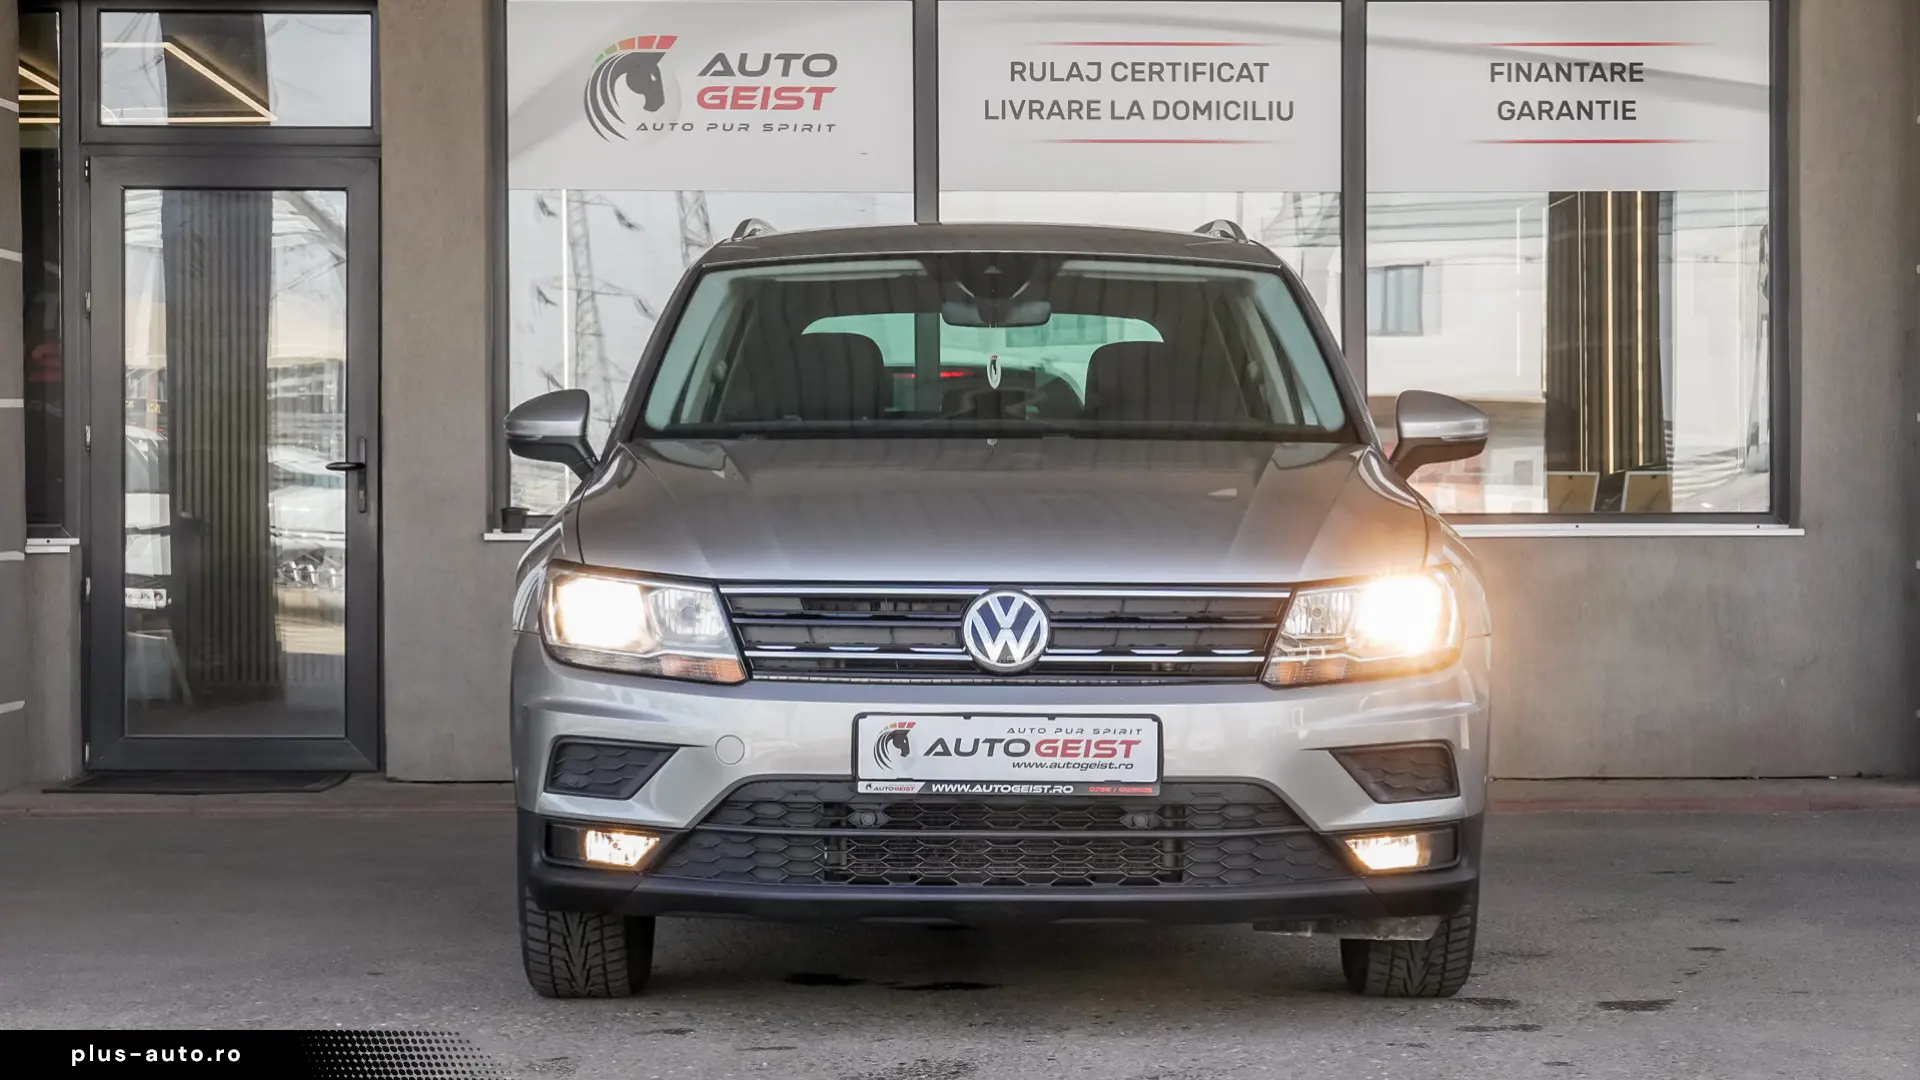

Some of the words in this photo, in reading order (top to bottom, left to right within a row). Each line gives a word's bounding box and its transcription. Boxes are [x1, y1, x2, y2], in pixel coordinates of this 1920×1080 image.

[696, 52, 838, 78] AUTO
[1009, 61, 1102, 83] RULAJ
[1110, 61, 1270, 83] CERTIFICAT
[1489, 62, 1645, 83] FINANTARE
[696, 85, 838, 111] GEIST
[984, 99, 1102, 121] LIVRARE
[1109, 99, 1146, 121] LA
[1152, 99, 1295, 122] DOMICILIU
[1496, 99, 1637, 121] GARANTIE
[635, 122, 695, 132] AUTO
[706, 122, 751, 133] PUR
[762, 122, 838, 133] SPIRIT
[1006, 726, 1047, 735] AUTO
[1054, 726, 1085, 736] PUR
[1092, 727, 1144, 736] SPIRIT
[1011, 759, 1135, 772] www.autogeist.ro
[931, 783, 1074, 794] WWW.AUTOGEIST.RO
